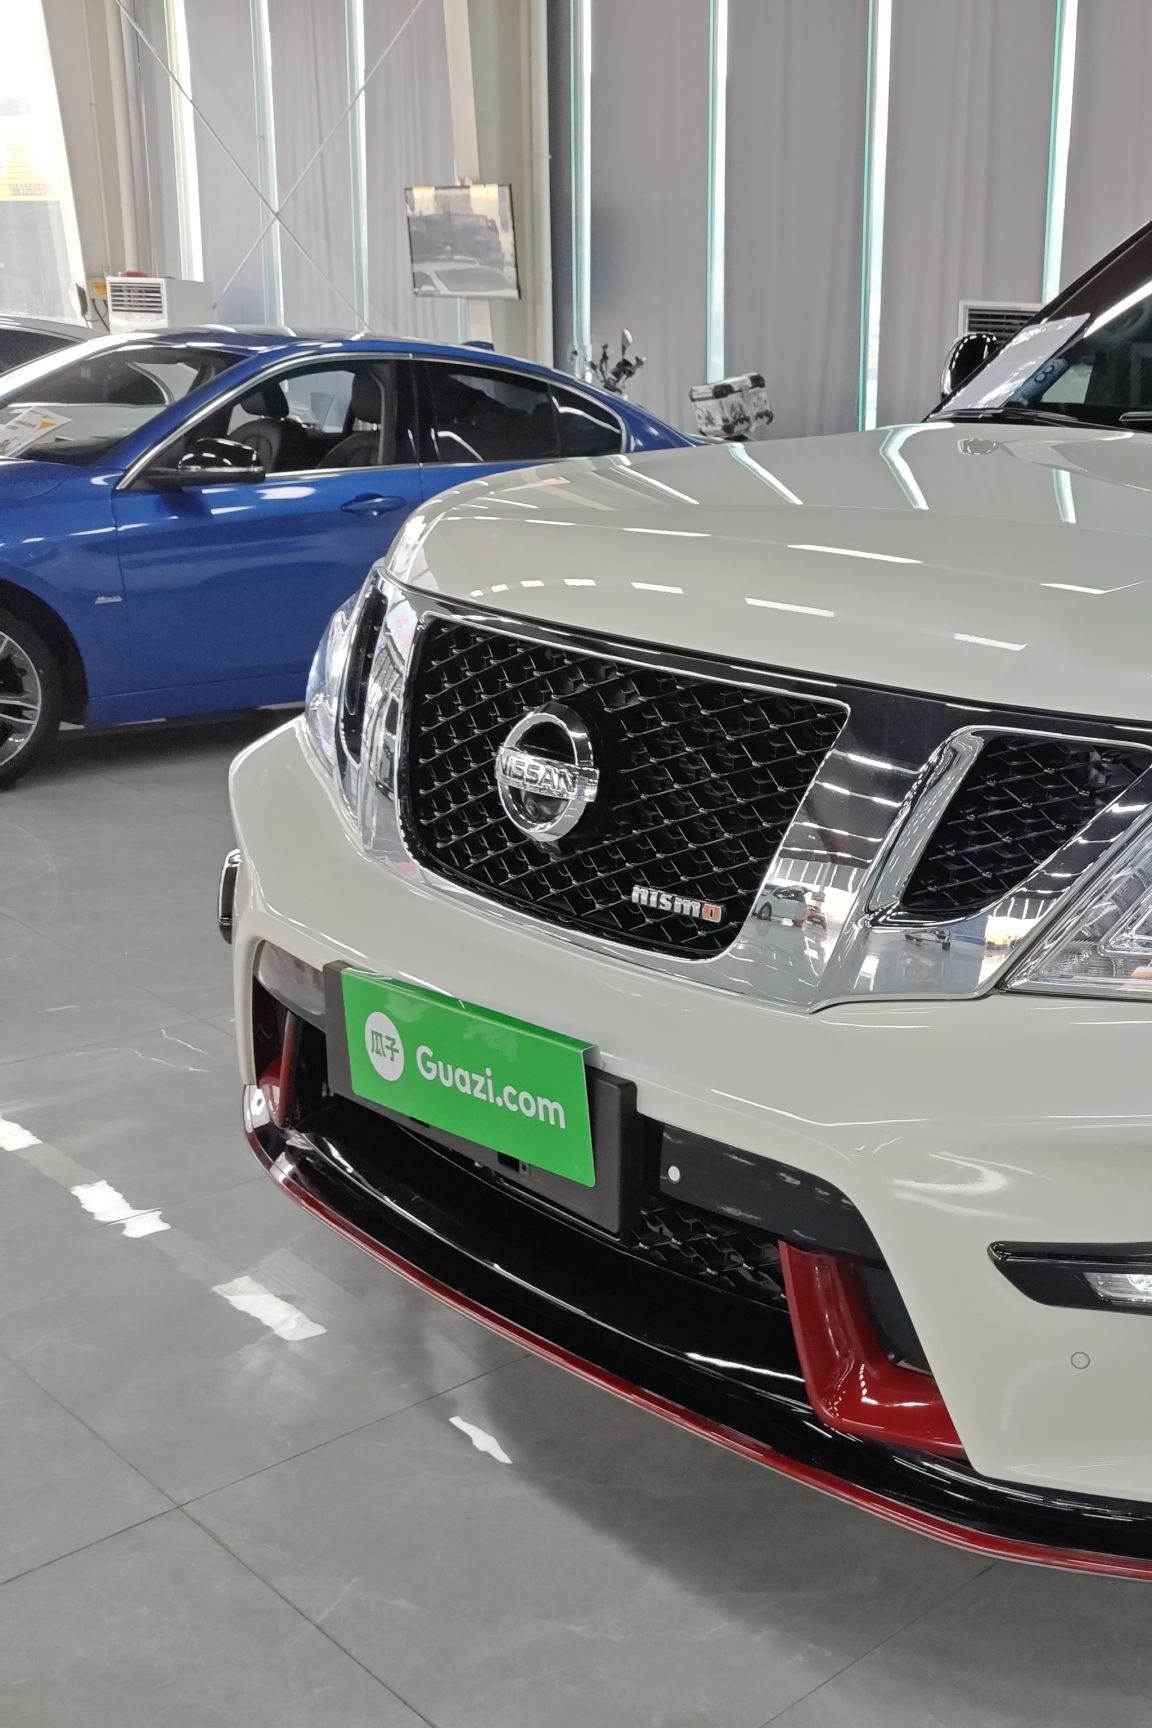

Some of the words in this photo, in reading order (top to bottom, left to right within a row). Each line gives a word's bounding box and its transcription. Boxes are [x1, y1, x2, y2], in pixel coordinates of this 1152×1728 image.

[500, 755, 578, 794] NISSAN
[370, 1029, 400, 1062] 瓜子
[416, 1045, 566, 1130] Guazi.com
